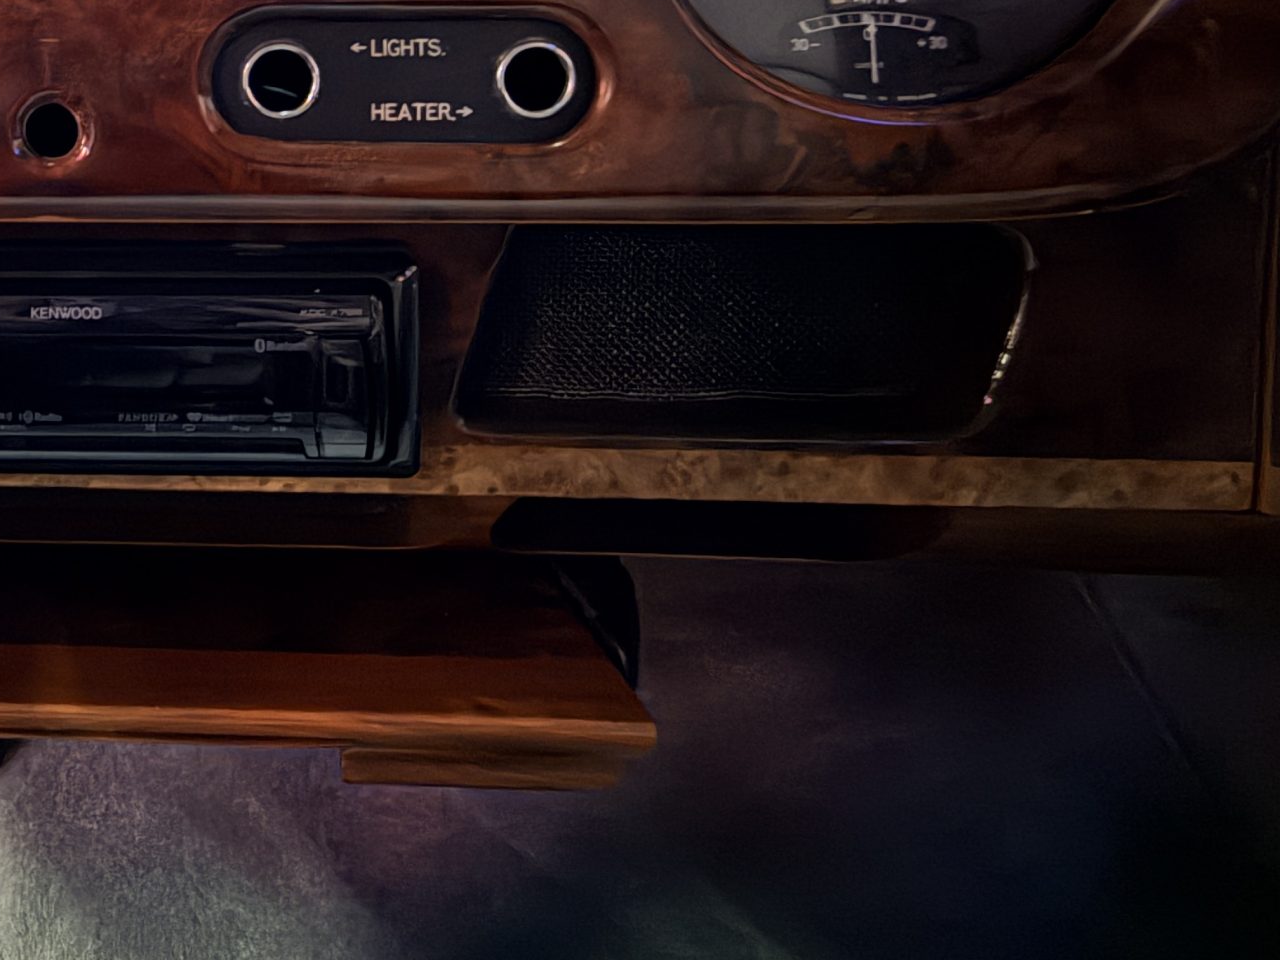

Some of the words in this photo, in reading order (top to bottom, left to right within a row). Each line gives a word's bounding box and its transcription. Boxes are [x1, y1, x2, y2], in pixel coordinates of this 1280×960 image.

[370, 38, 447, 58] LIGHTS.
[371, 102, 457, 122] HEATER.
[30, 305, 103, 321] KENWOOD
